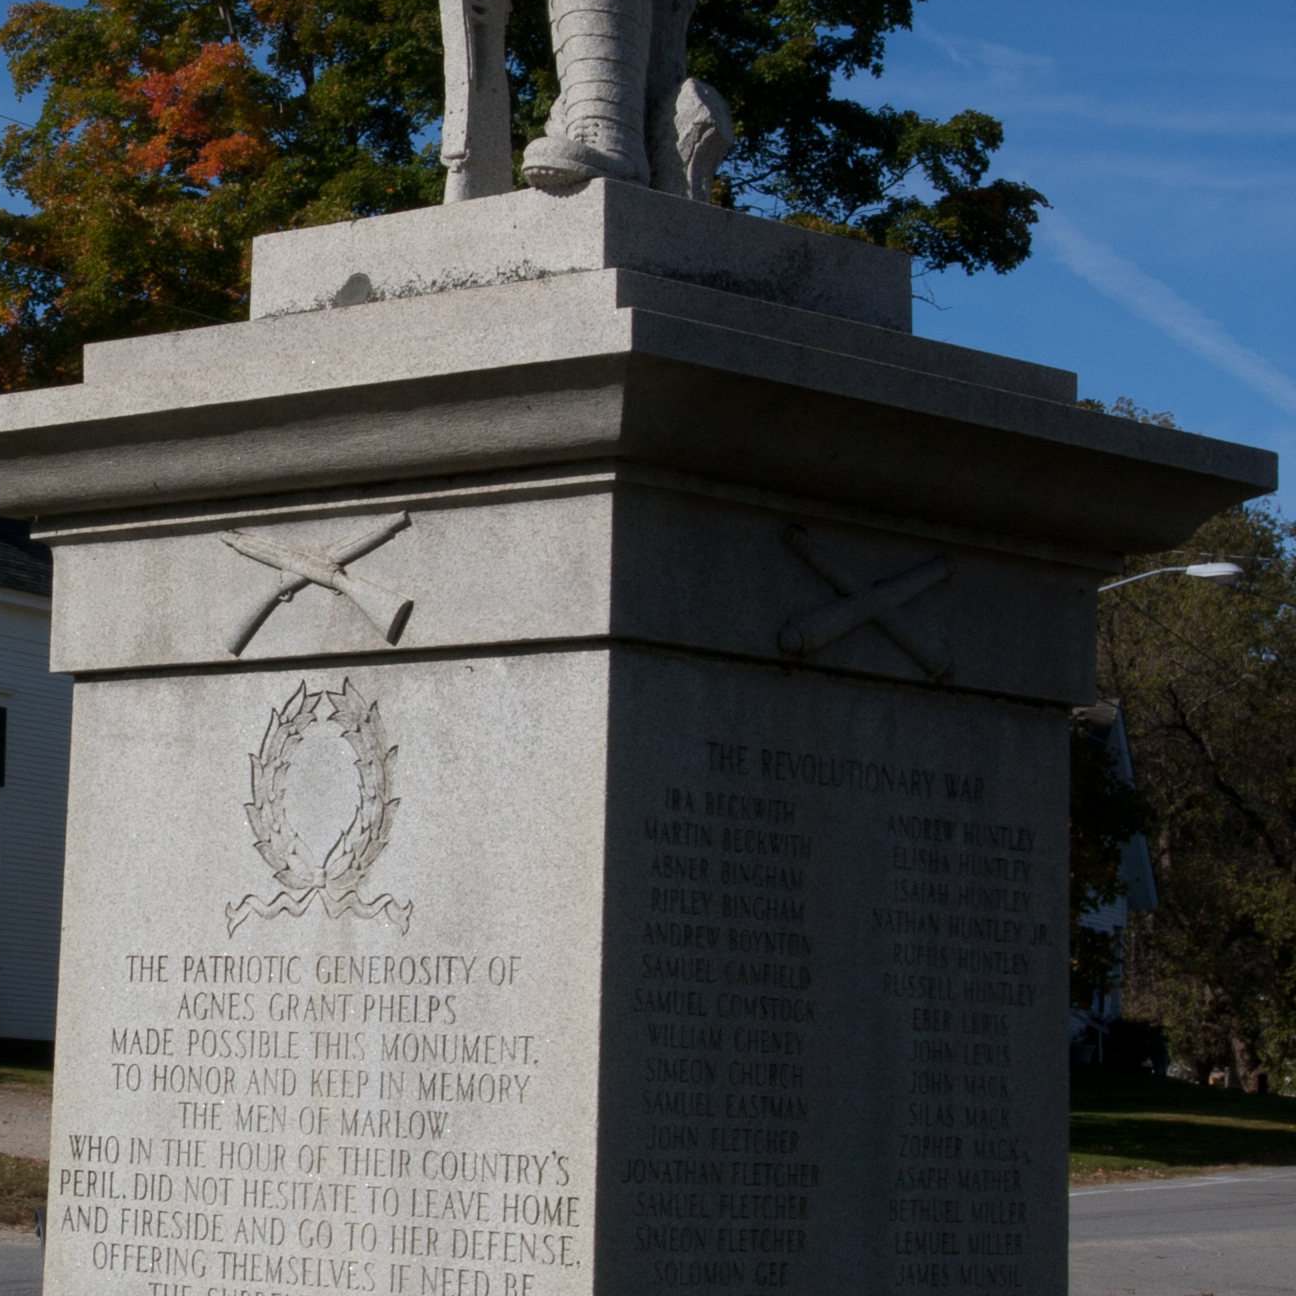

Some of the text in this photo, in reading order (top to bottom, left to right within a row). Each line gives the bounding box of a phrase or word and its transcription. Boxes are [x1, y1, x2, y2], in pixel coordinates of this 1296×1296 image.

[706, 741, 984, 802] THE REVOLUTIONARY WAR
[645, 819, 811, 859] MARTIN BECKWITH
[651, 855, 803, 891] ABNER BINGHAM
[651, 887, 803, 924] RIPLEY BINGHAM
[643, 922, 812, 956] ANDREW BOYNTON
[126, 955, 521, 985] THE PATRIOTIC GENEROSITY OF
[642, 955, 812, 991] SAMUEL CANFIELD
[178, 993, 456, 1024] AGNES GRANT PHELPS
[633, 988, 817, 1023] SAMUEL COMSTOCK
[112, 1028, 539, 1066] MADE POSSIBLE THIS MONUMENT.
[647, 1023, 803, 1057] WILLIAM CHENEY
[909, 1040, 1011, 1067] JOHN LEWIS
[112, 1063, 531, 1103] TO HONOR AND KEEP IN MEMORY
[646, 1057, 803, 1090] SIMEON CHURCH
[179, 1102, 448, 1139] THE MEN OF MARLOW
[642, 1091, 806, 1120] SAMUEL EASTMAN
[646, 1125, 799, 1154] JOHN FLETCHER
[69, 1135, 570, 1185] WHO IN THE HOUR OF THEIR COUNTRY'S
[622, 1159, 819, 1188] JONATHAN FLETCHER
[60, 1170, 580, 1227] PERIL. DID NOT HESITATE TO LEAVE HOME
[61, 1206, 580, 1269] AND FIRESIDE AND GO TO HER DEFENSE,
[93, 1242, 206, 1278] OFFERING
[218, 1251, 375, 1292] THEMSELVES
[390, 1264, 412, 1295] IF
